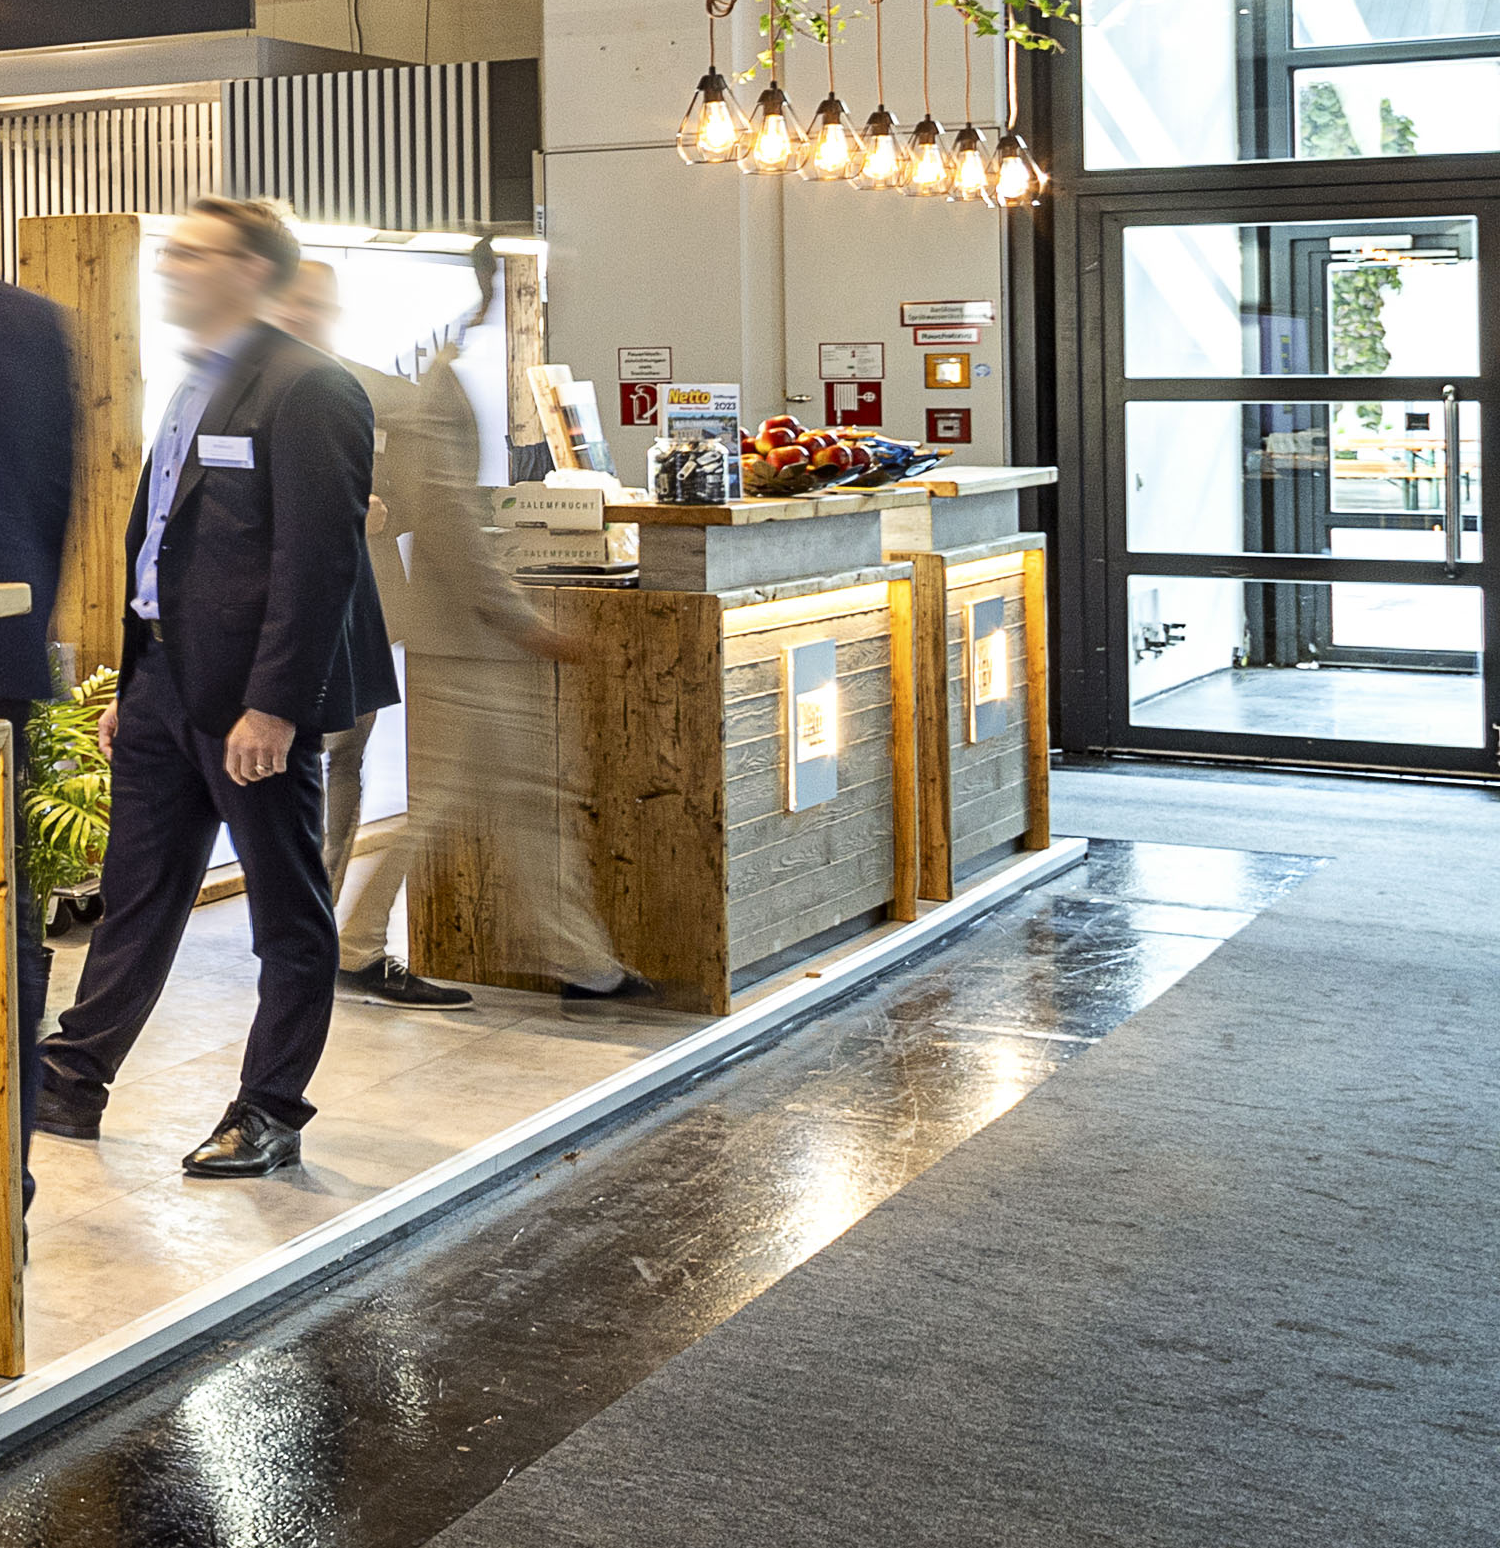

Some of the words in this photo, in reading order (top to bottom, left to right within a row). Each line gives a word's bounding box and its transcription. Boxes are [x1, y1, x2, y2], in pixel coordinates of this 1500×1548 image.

[668, 388, 711, 404] Netto
[714, 402, 737, 411] 2023
[520, 501, 596, 510] SALEMFRUCHT
